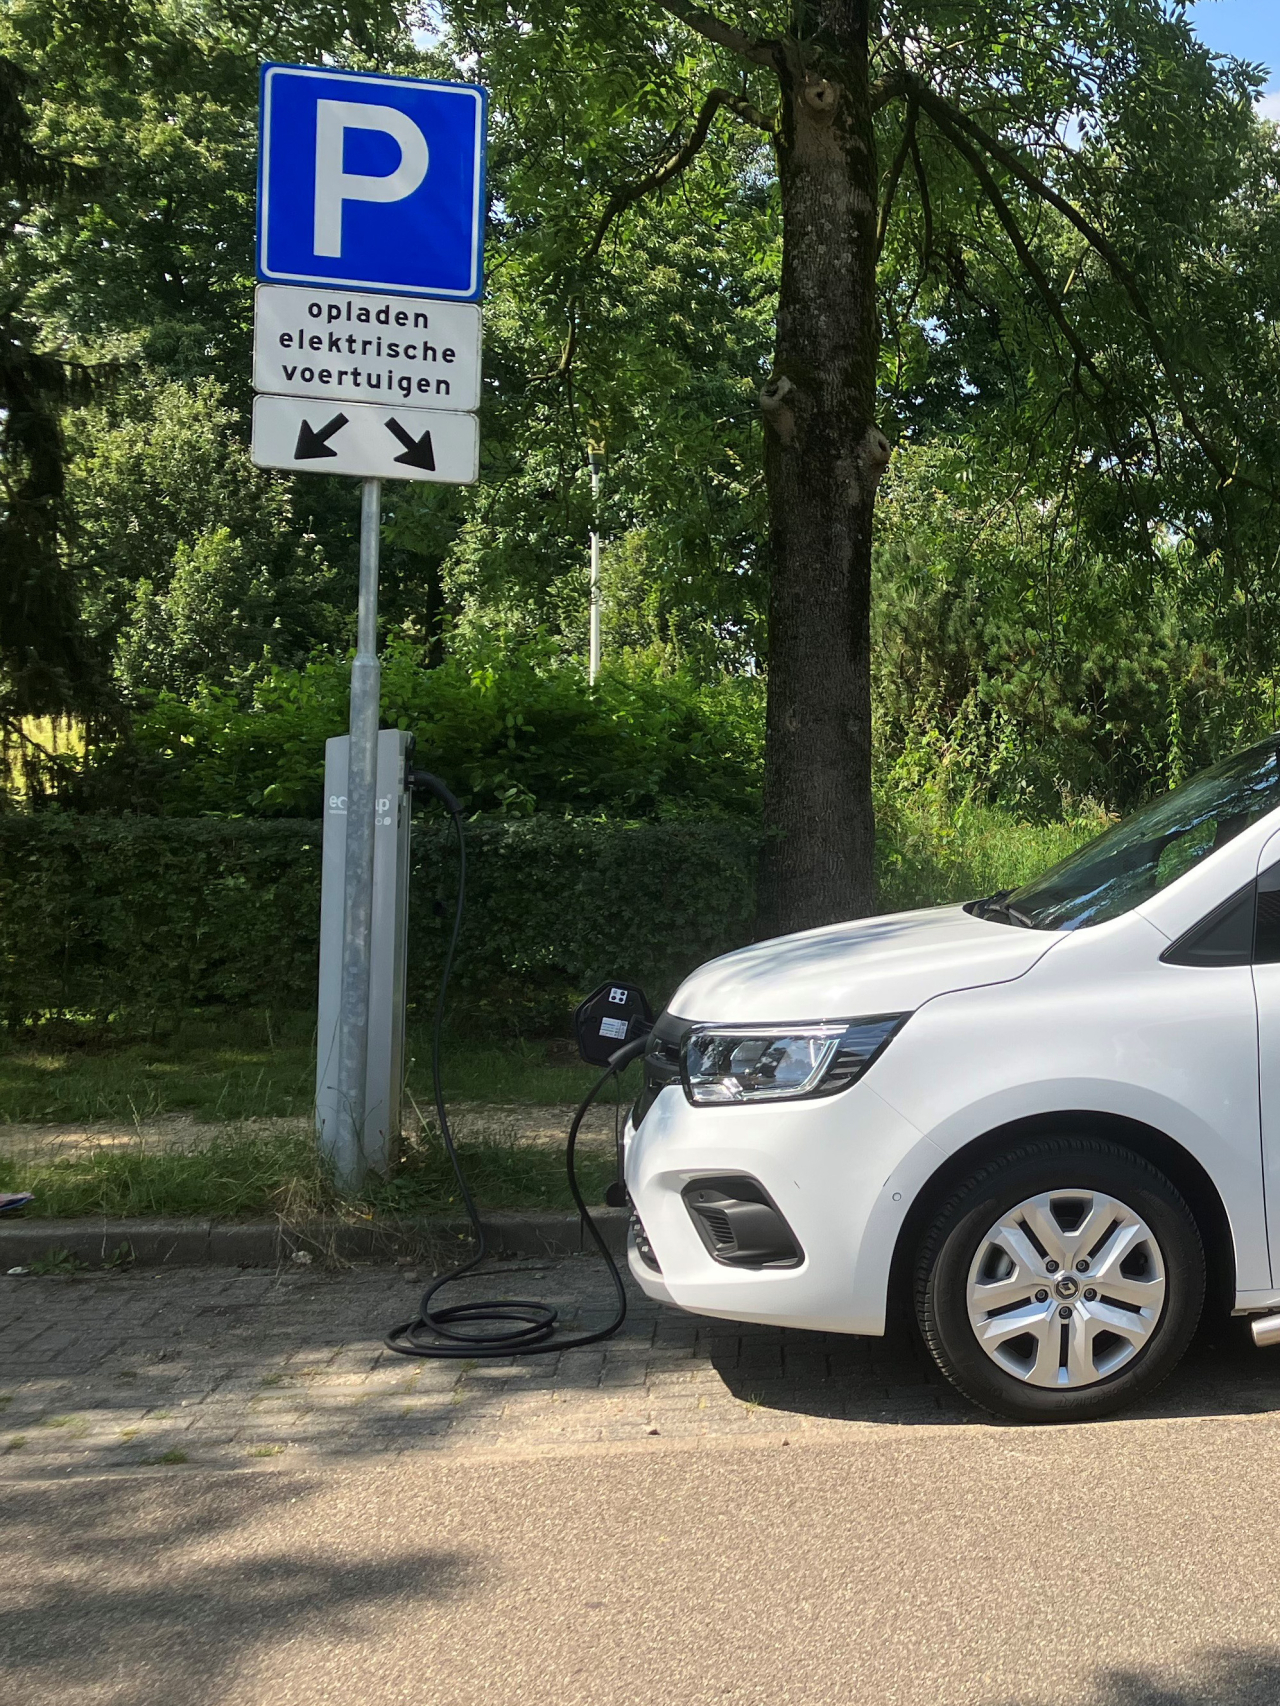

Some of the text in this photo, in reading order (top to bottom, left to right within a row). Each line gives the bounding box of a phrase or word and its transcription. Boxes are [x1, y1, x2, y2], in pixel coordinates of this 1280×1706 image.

[313, 98, 429, 258] P
[307, 300, 428, 329] opladen
[279, 328, 456, 364] elektrische
[281, 364, 450, 399] voertuigen
